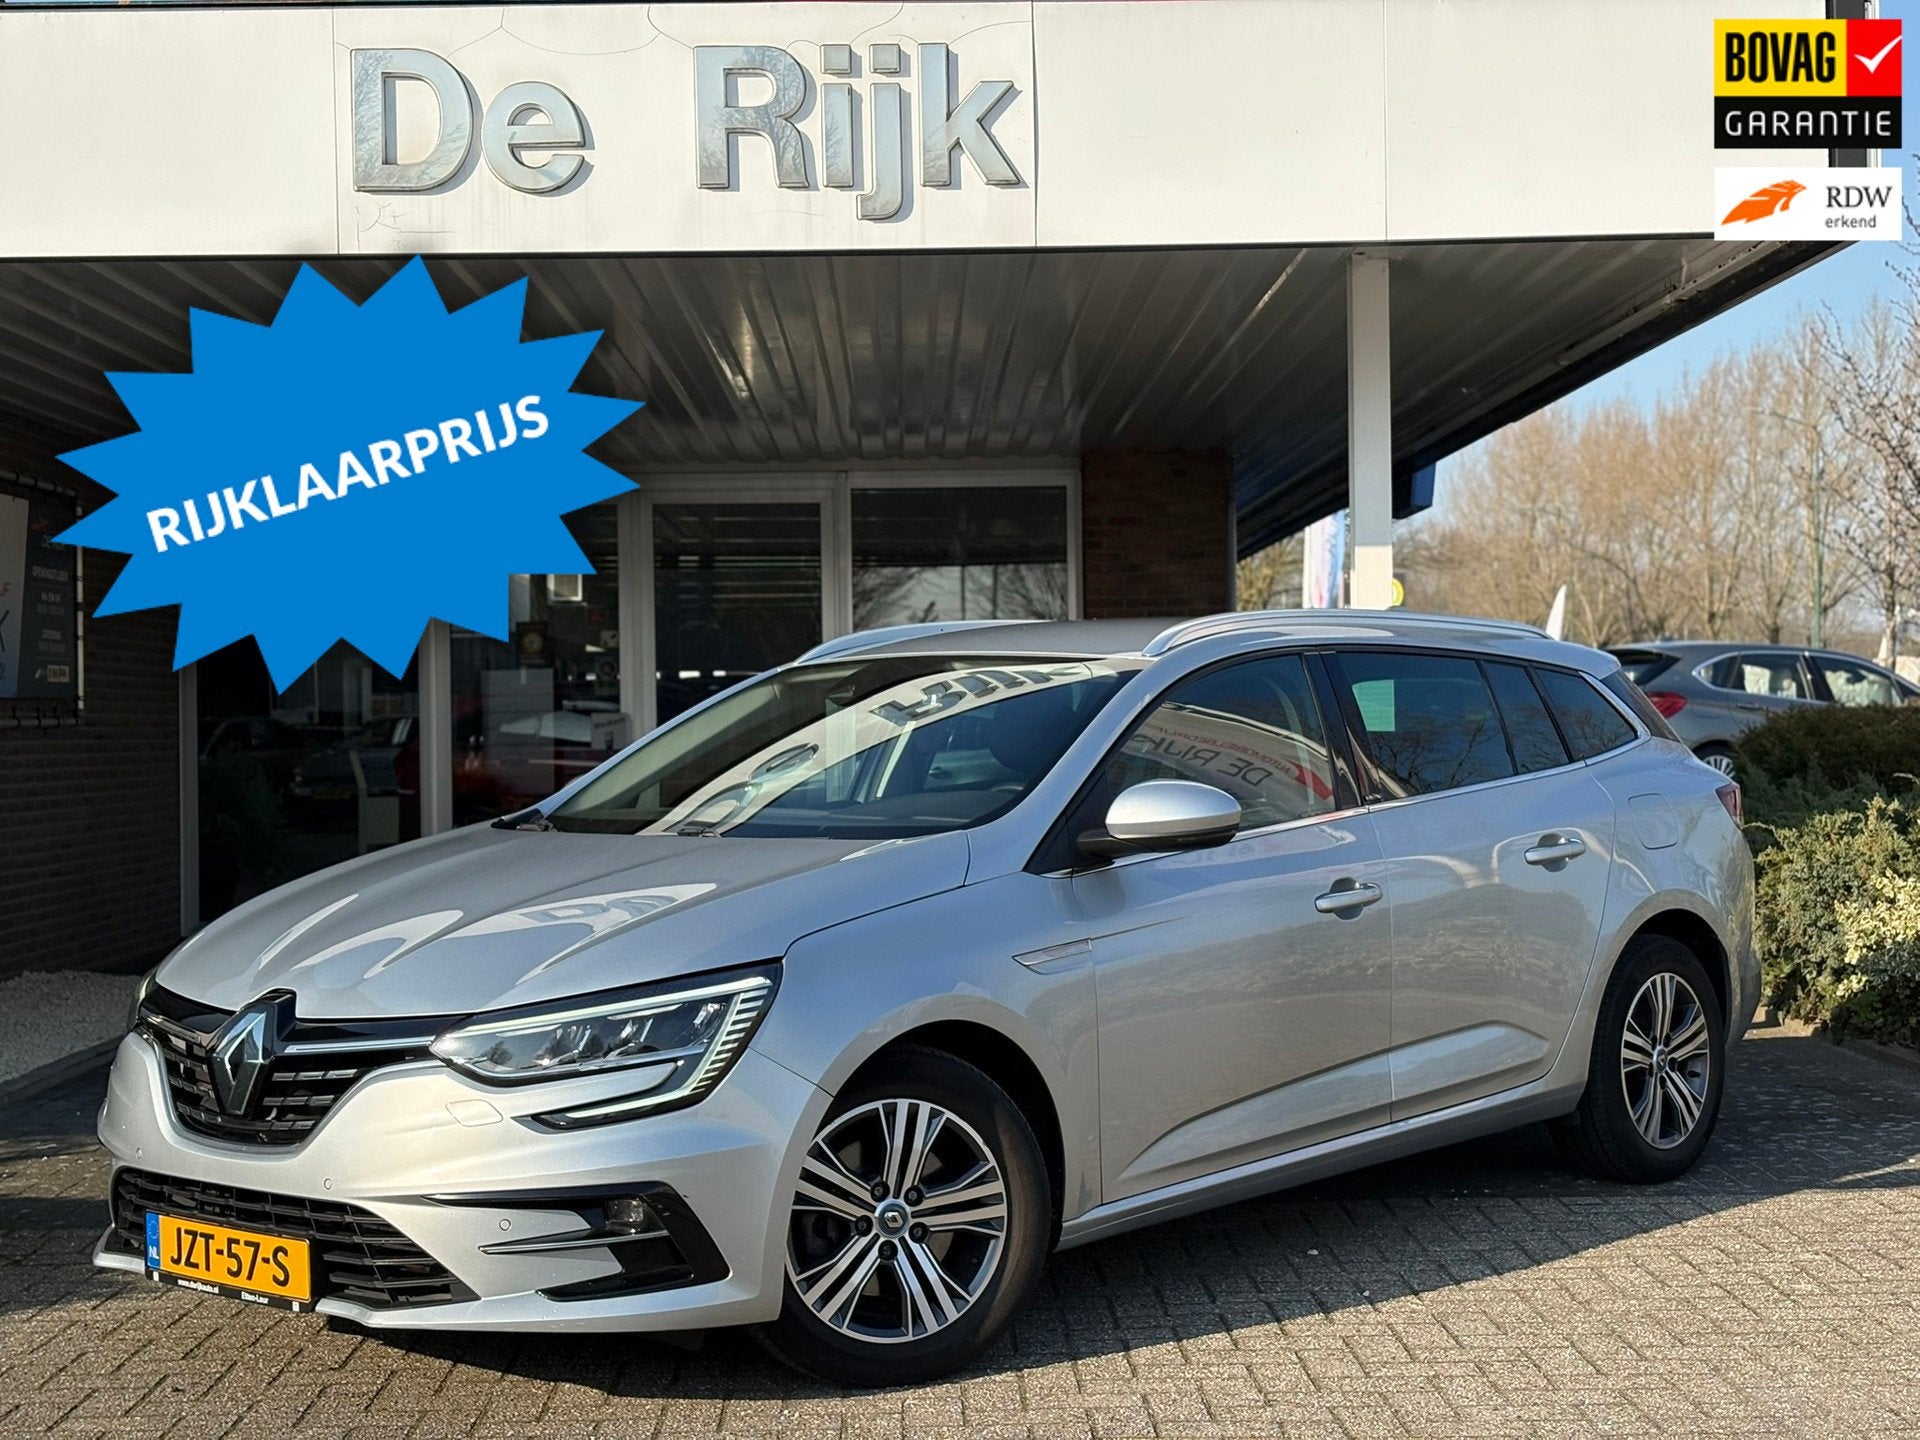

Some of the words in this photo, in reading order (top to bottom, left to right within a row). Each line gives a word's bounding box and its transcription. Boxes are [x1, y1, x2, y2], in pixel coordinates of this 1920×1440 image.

[350, 47, 586, 193] De
[694, 42, 1022, 221] Rijk
[149, 1245, 160, 1260] NL
[170, 1227, 290, 1287] JZT-57-S
